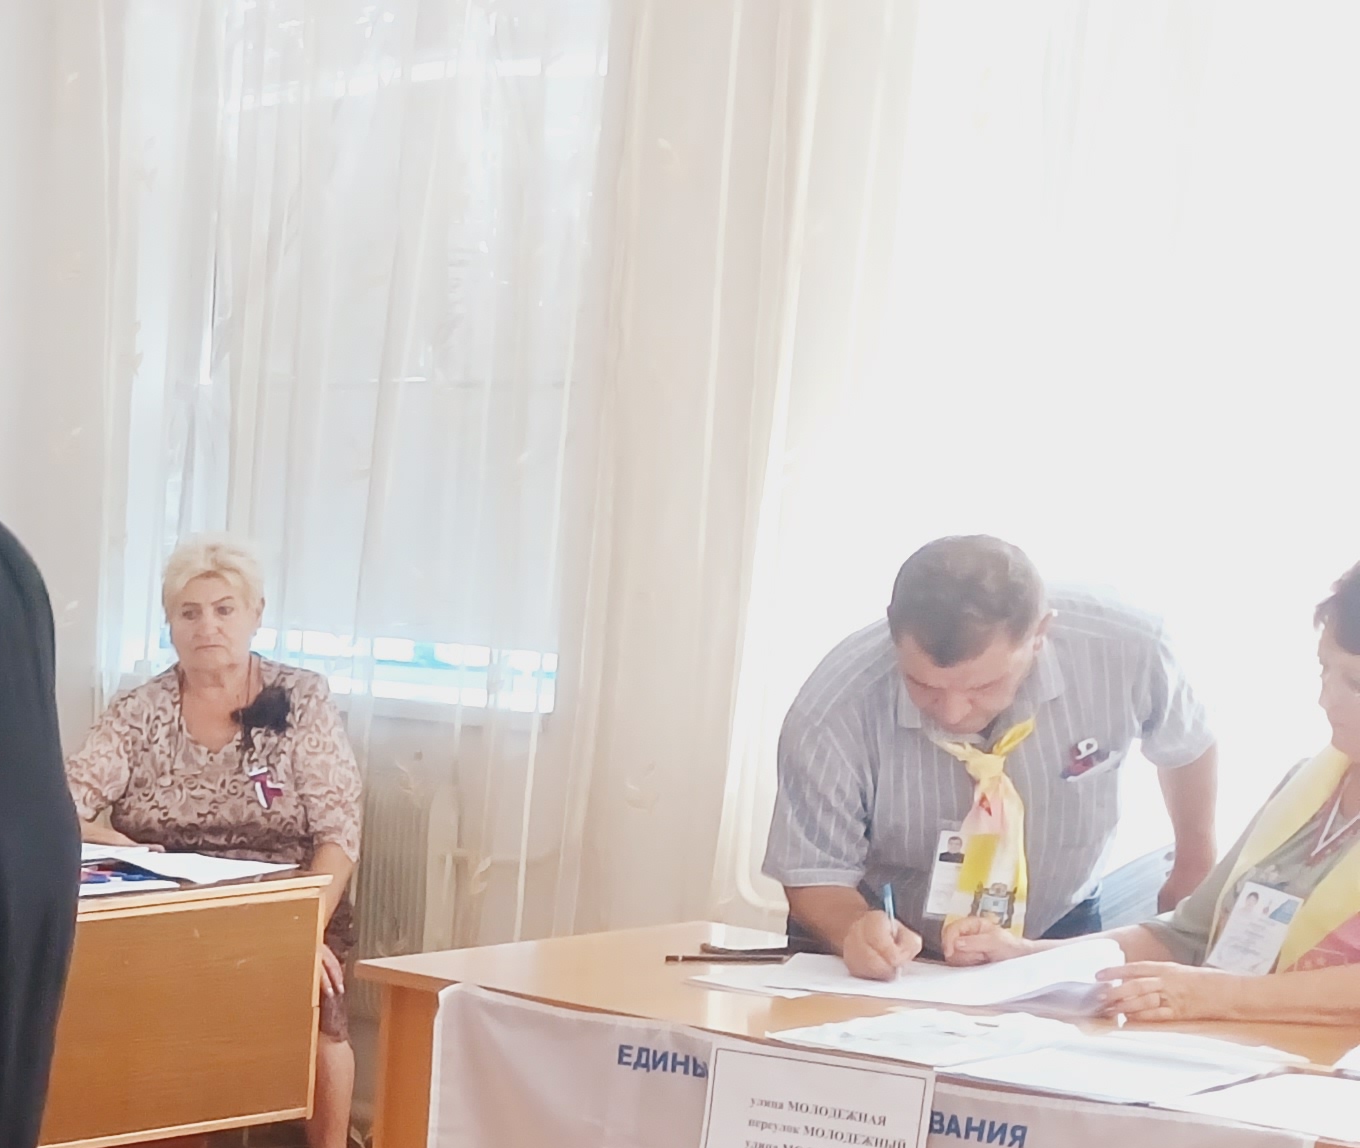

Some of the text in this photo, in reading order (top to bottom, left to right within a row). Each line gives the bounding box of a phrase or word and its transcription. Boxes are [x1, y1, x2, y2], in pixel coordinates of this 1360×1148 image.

[617, 1044, 1028, 1148] ЕДИНЫ ВАНИЯ
[748, 1118, 800, 1136] переулок
[749, 1097, 887, 1127] улица МОЛОДЕЖНАЯ
